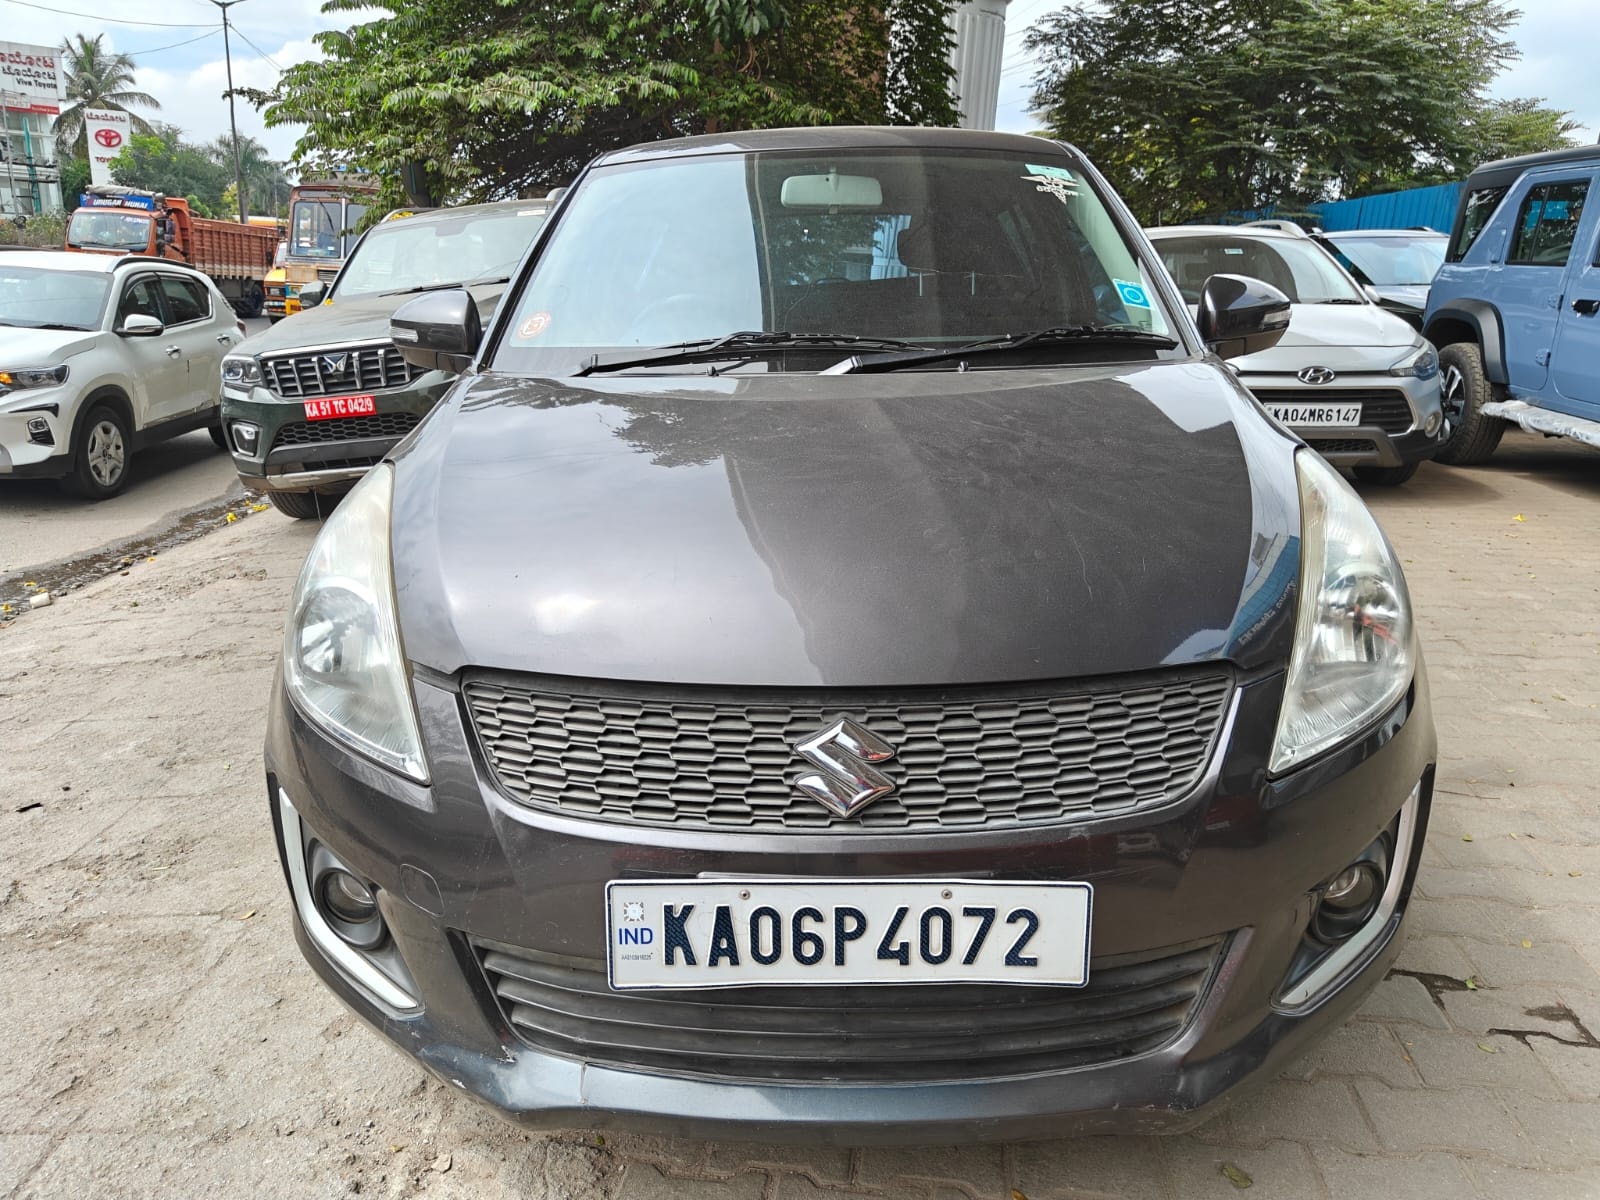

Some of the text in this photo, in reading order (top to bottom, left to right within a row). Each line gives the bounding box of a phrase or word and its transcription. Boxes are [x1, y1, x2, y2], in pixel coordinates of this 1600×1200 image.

[16, 77, 57, 89] Viva Toyota
[304, 402, 319, 417] KA
[320, 400, 332, 416] 51
[333, 399, 347, 414] TC
[1273, 408, 1360, 422] KA04MR6147
[618, 927, 654, 945] IND
[662, 903, 1040, 967] KA06P4072
